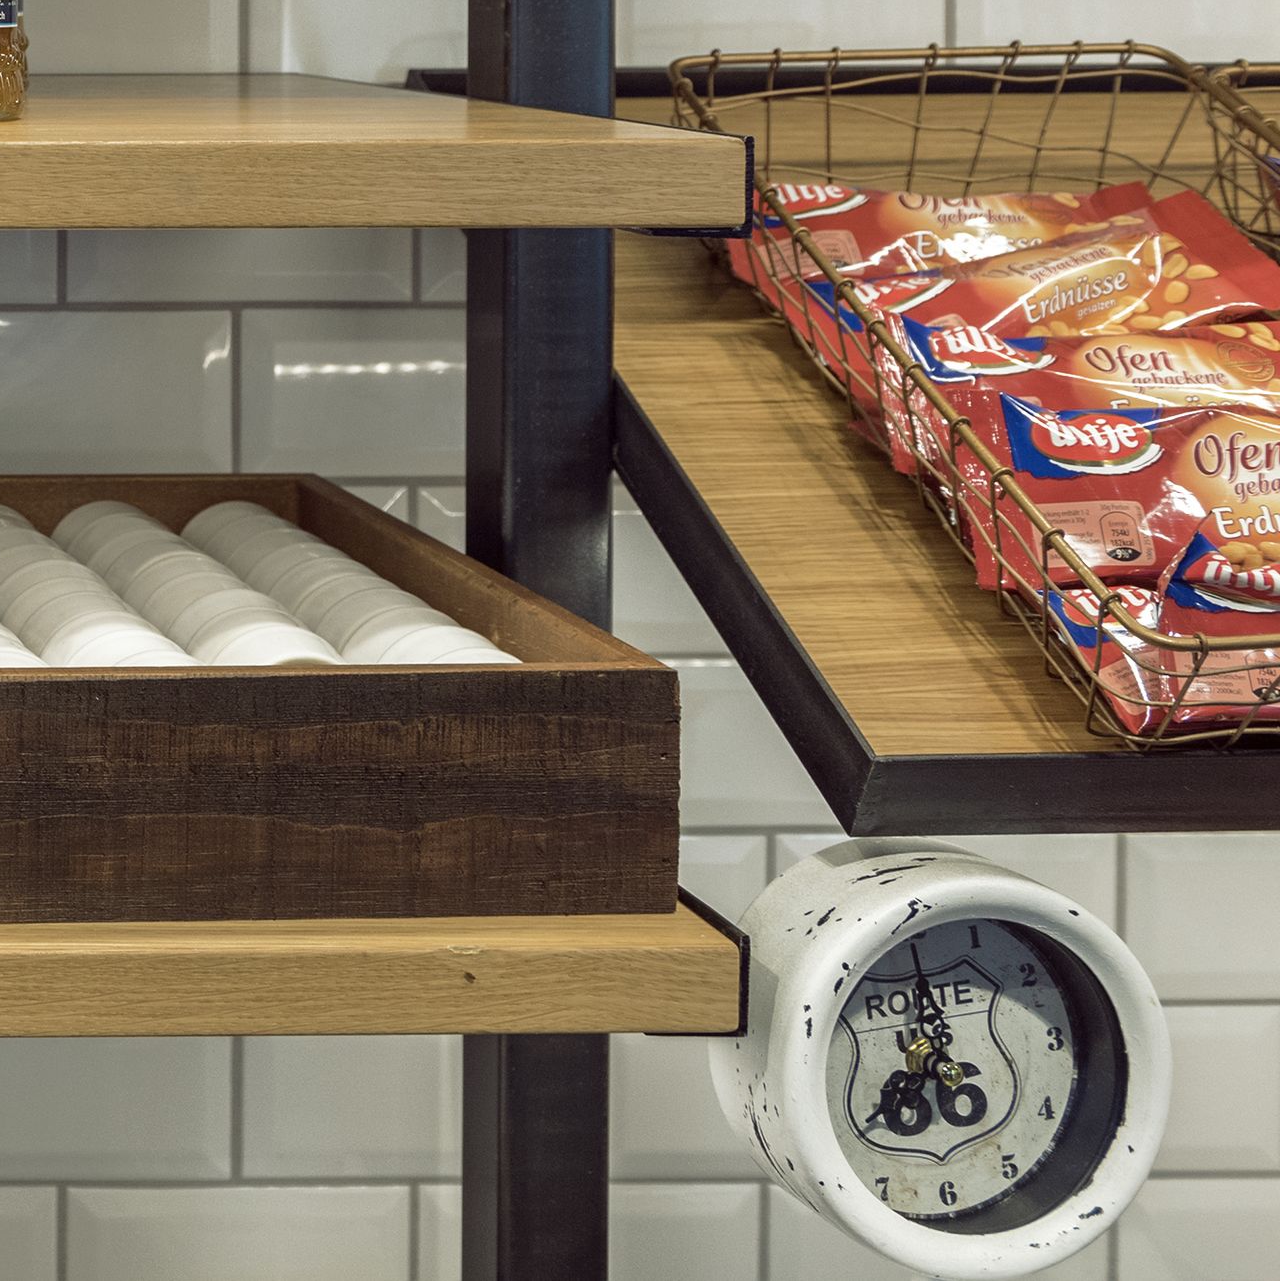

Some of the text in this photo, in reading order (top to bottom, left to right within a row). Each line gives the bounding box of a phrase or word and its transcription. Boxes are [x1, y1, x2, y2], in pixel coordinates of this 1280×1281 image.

[1027, 244, 1112, 284] gebackene
[1020, 268, 1130, 324] Erdnüsse
[1076, 299, 1117, 318] gesalzen
[1084, 345, 1174, 375] Ofen
[1131, 369, 1227, 393] gebackene
[1234, 473, 1280, 501] geba
[967, 925, 982, 950] 1
[1019, 962, 1038, 988] 2
[863, 978, 974, 1021] ROUTE
[1046, 1026, 1064, 1052] 3
[1037, 1095, 1056, 1121] 4
[1001, 1153, 1020, 1180] 5
[874, 1176, 890, 1202] 7
[939, 1180, 959, 1206] 6
